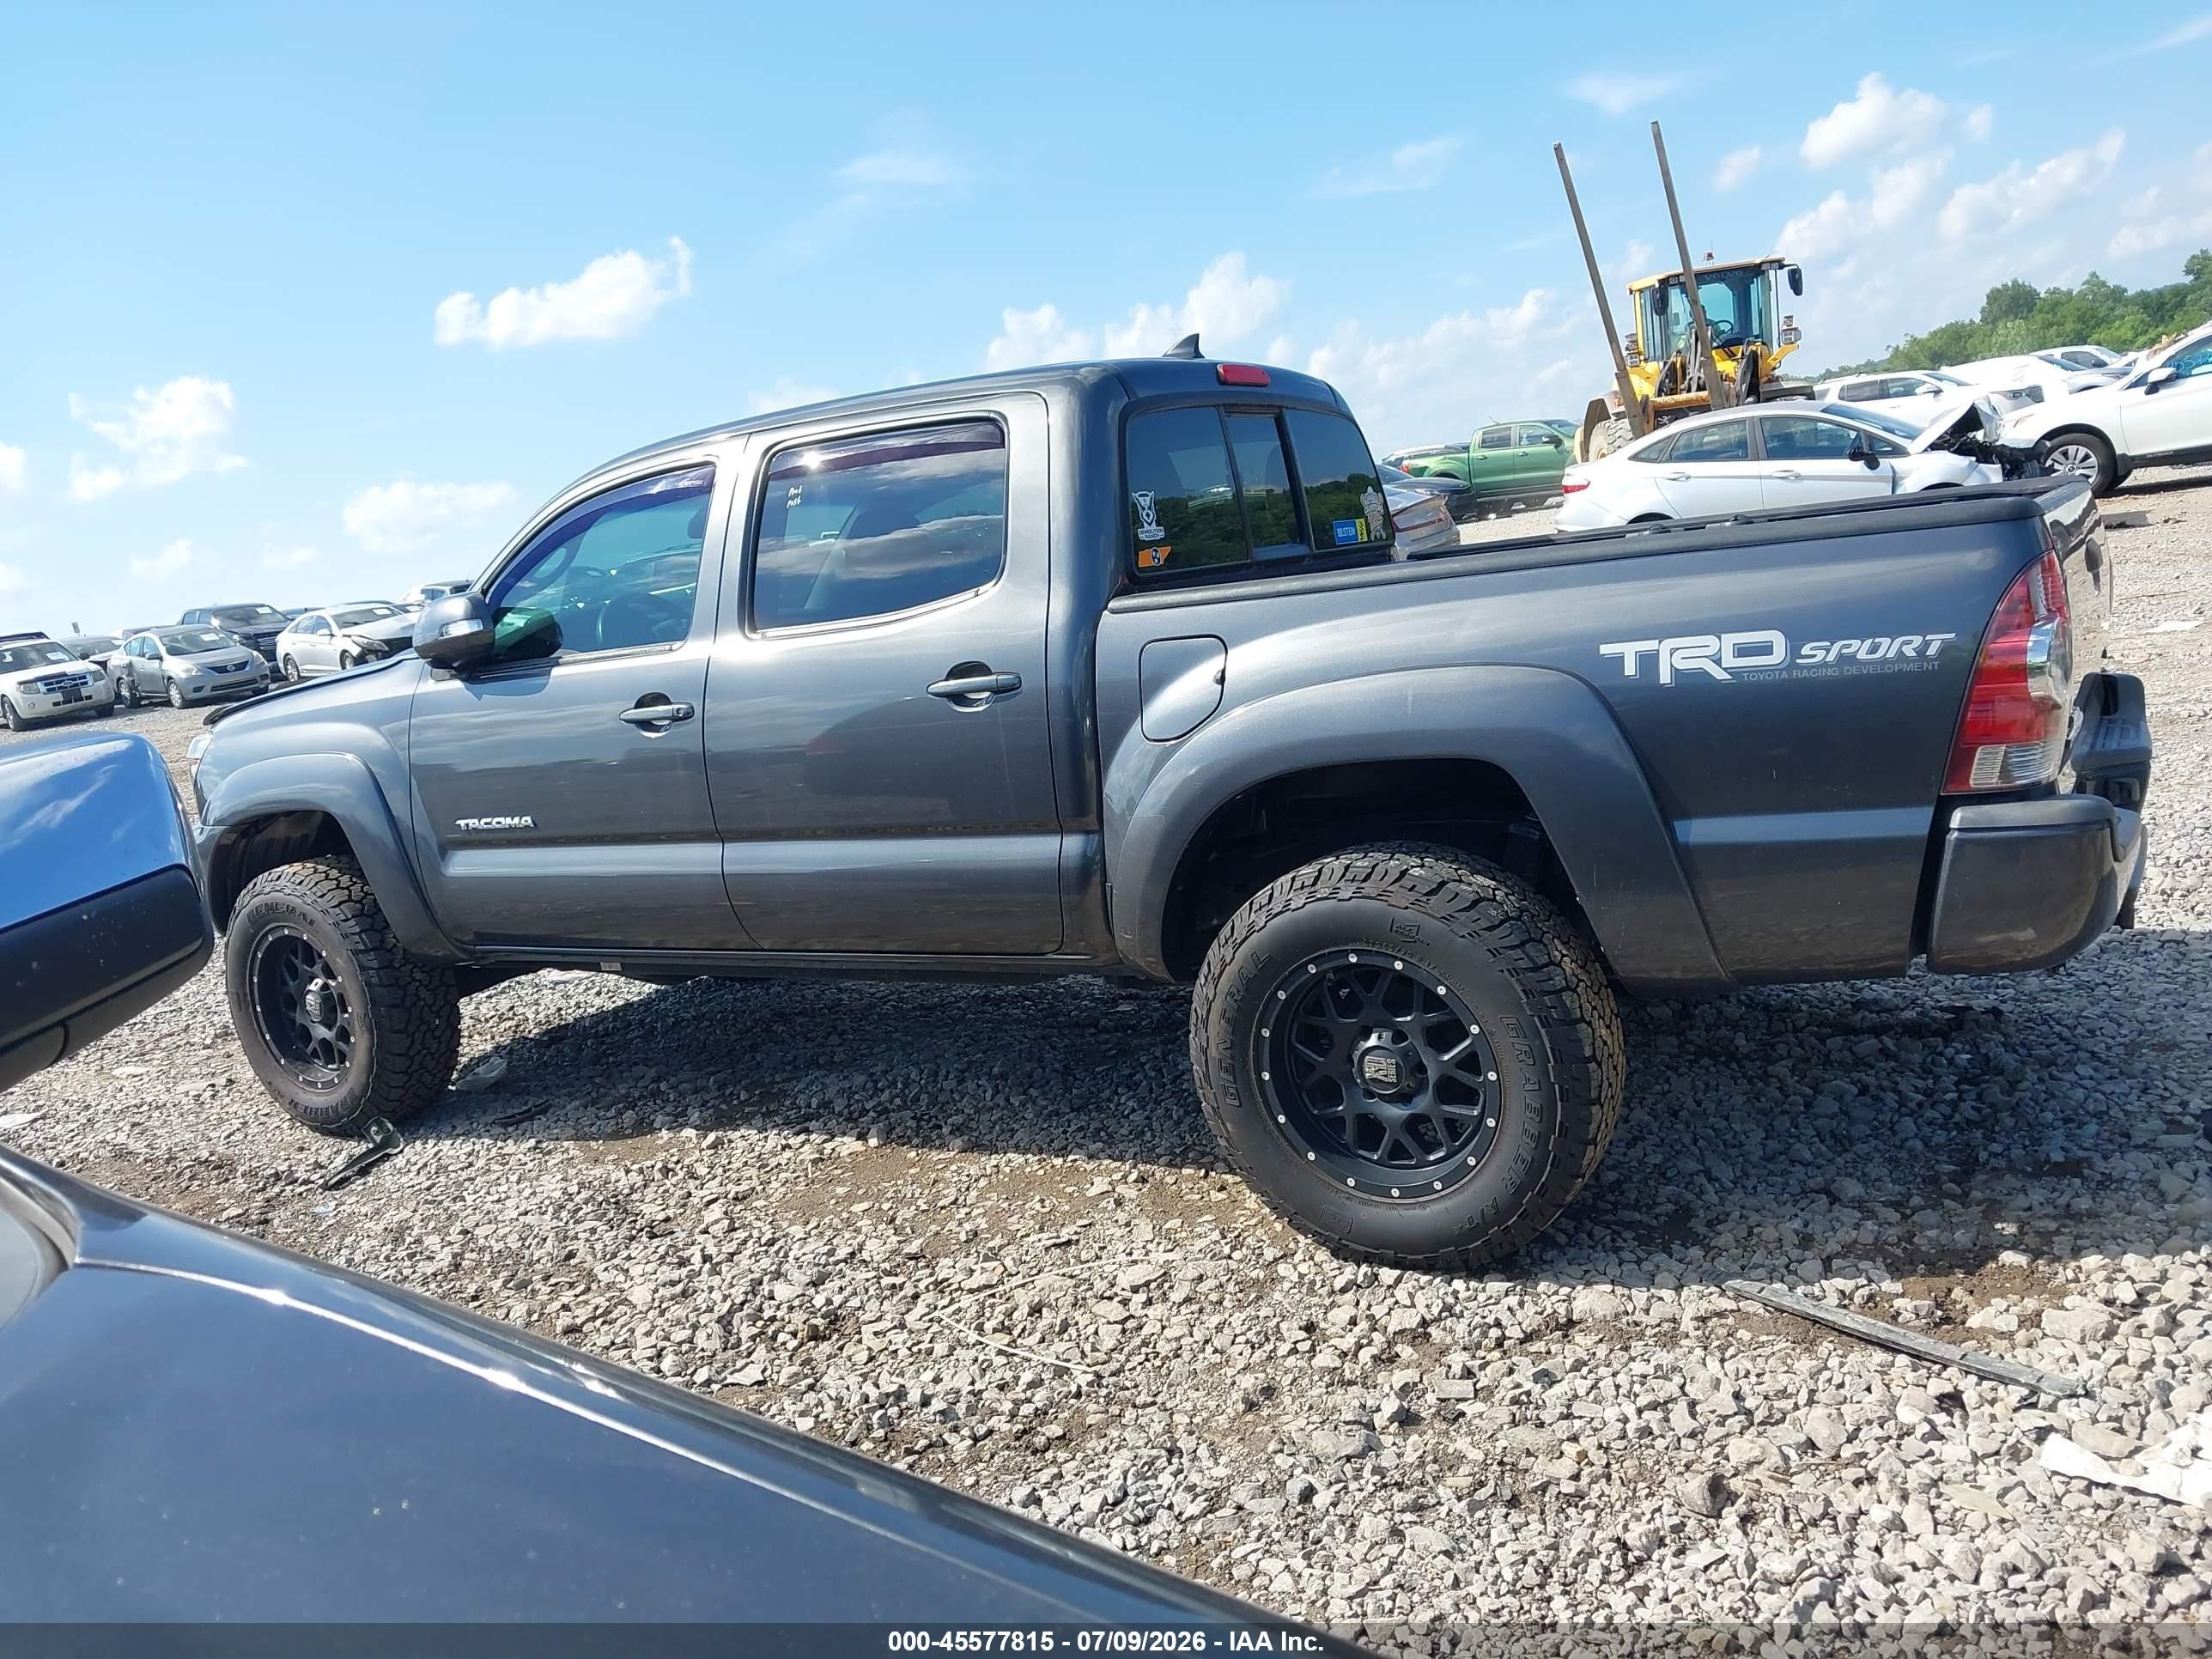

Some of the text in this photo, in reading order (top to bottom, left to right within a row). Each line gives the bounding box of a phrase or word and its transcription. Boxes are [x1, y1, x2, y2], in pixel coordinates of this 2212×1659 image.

[1599, 629, 1957, 687] TRD SPORT
[1742, 660, 1941, 683] TOYOTA RACING DEVELOPMENT
[454, 815, 536, 831] TACOMA
[246, 901, 315, 927] GENERAL
[1216, 950, 1272, 1109] GENERAL
[1500, 1015, 1543, 1196] GRABBER
